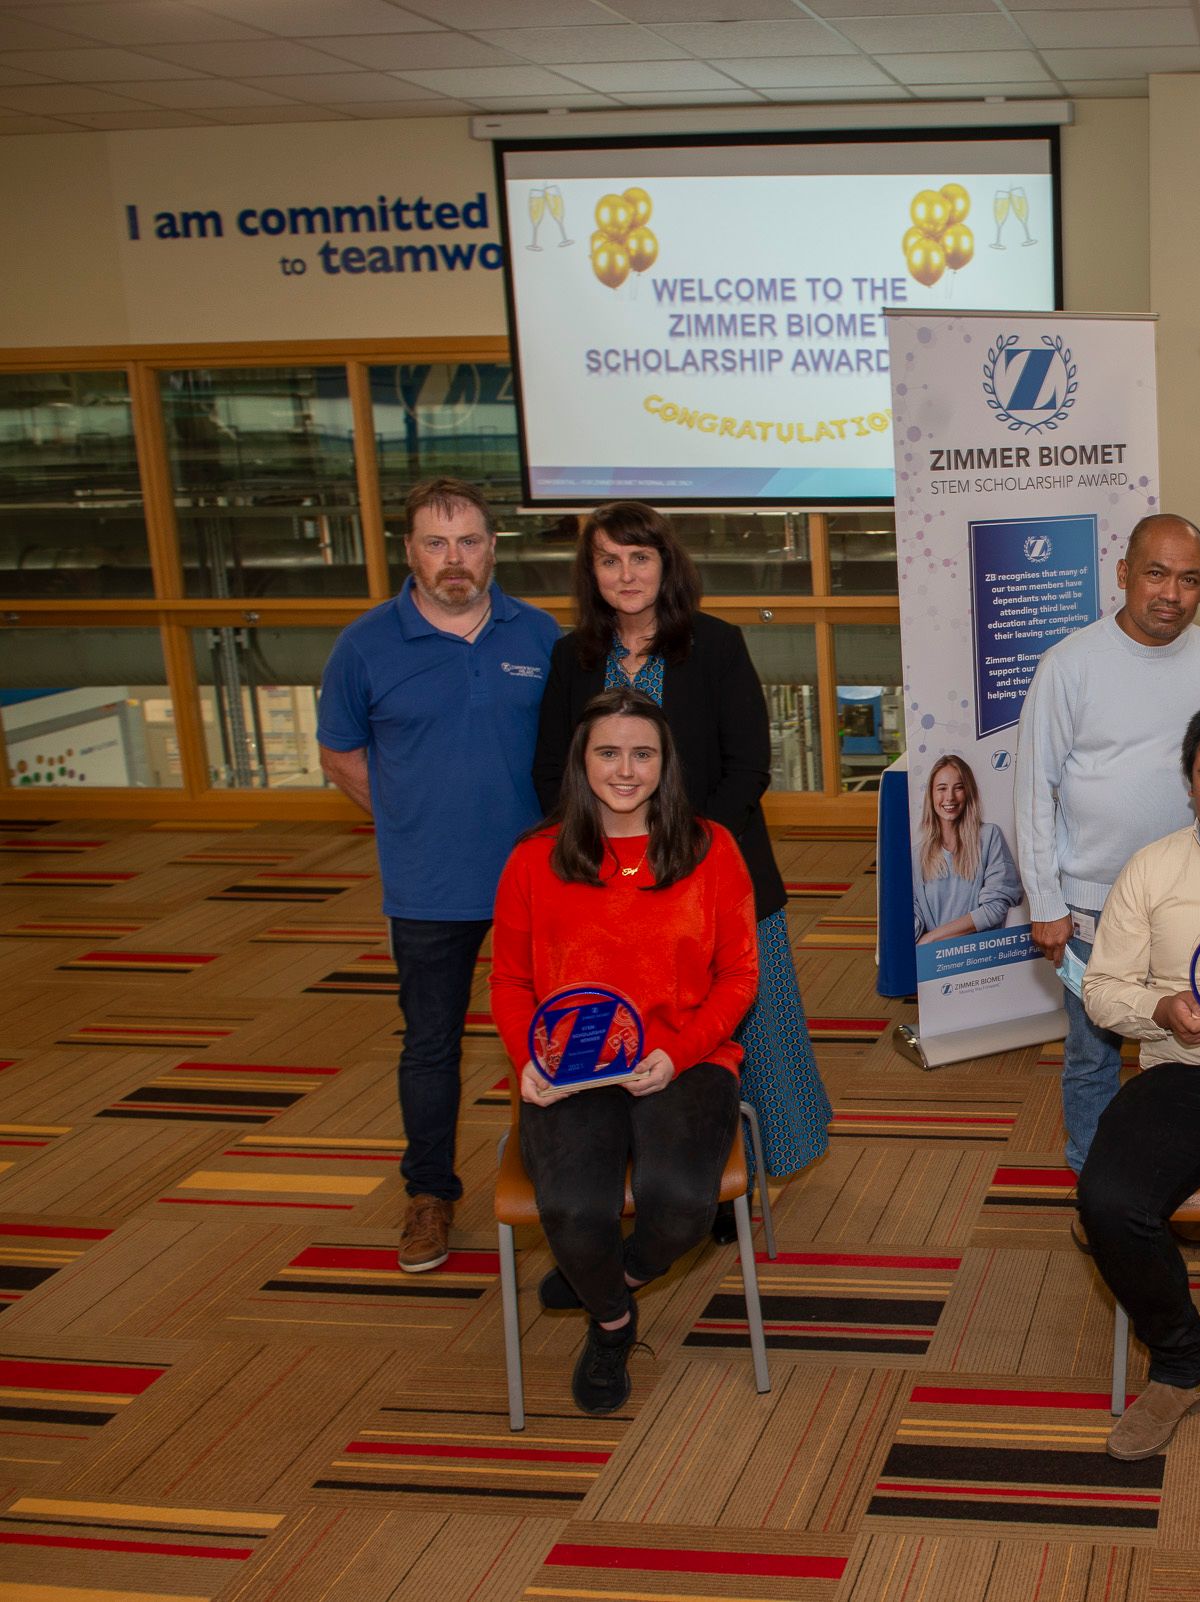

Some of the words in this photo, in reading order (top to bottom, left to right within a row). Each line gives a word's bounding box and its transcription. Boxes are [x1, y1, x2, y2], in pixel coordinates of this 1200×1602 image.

[125, 204, 141, 241] I
[154, 205, 224, 240] am
[237, 193, 489, 236] committed
[279, 256, 307, 276] to
[652, 278, 796, 301] WELCOME
[806, 278, 843, 300] TO
[852, 277, 907, 300] THE
[669, 314, 777, 337] ZIMMER
[585, 349, 783, 373] SCHOLARSHIP
[643, 394, 893, 443] CONGRATULATIO
[929, 447, 1031, 471] ZIMMER
[1038, 444, 1127, 466] BIOMET
[931, 480, 970, 495] STEM
[975, 475, 1073, 492] SCHOLARSHIP
[1078, 472, 1128, 487] AWARD
[998, 571, 1040, 582] recognises
[1042, 569, 1057, 578] that
[1059, 569, 1078, 578] many
[1080, 566, 1088, 575] of
[1007, 584, 1027, 592] team
[1029, 581, 1064, 590] members
[1066, 580, 1082, 588] have
[992, 596, 1039, 605] dependants
[1040, 592, 1057, 601] who
[1000, 607, 1038, 617] attending
[1040, 604, 1058, 613] third
[1060, 602, 1077, 611] level
[987, 620, 1026, 630] education
[1028, 618, 1047, 626] after
[1049, 614, 1089, 624] completing
[994, 632, 1014, 640] their
[1015, 630, 1043, 638] leaving
[985, 655, 1015, 665] Zimmer
[1017, 653, 1042, 662] Biome
[989, 667, 1020, 677] support
[996, 678, 1011, 687] and
[1013, 677, 1031, 685] their
[987, 689, 1016, 700] helping
[936, 944, 977, 959] ZIMMER
[979, 935, 1018, 950] BIOMET
[936, 960, 964, 972] Zimmer
[966, 954, 992, 966] Biomet
[998, 948, 1027, 960] Building
[955, 979, 980, 991] ZIMMER
[981, 974, 1005, 985] BIOMET
